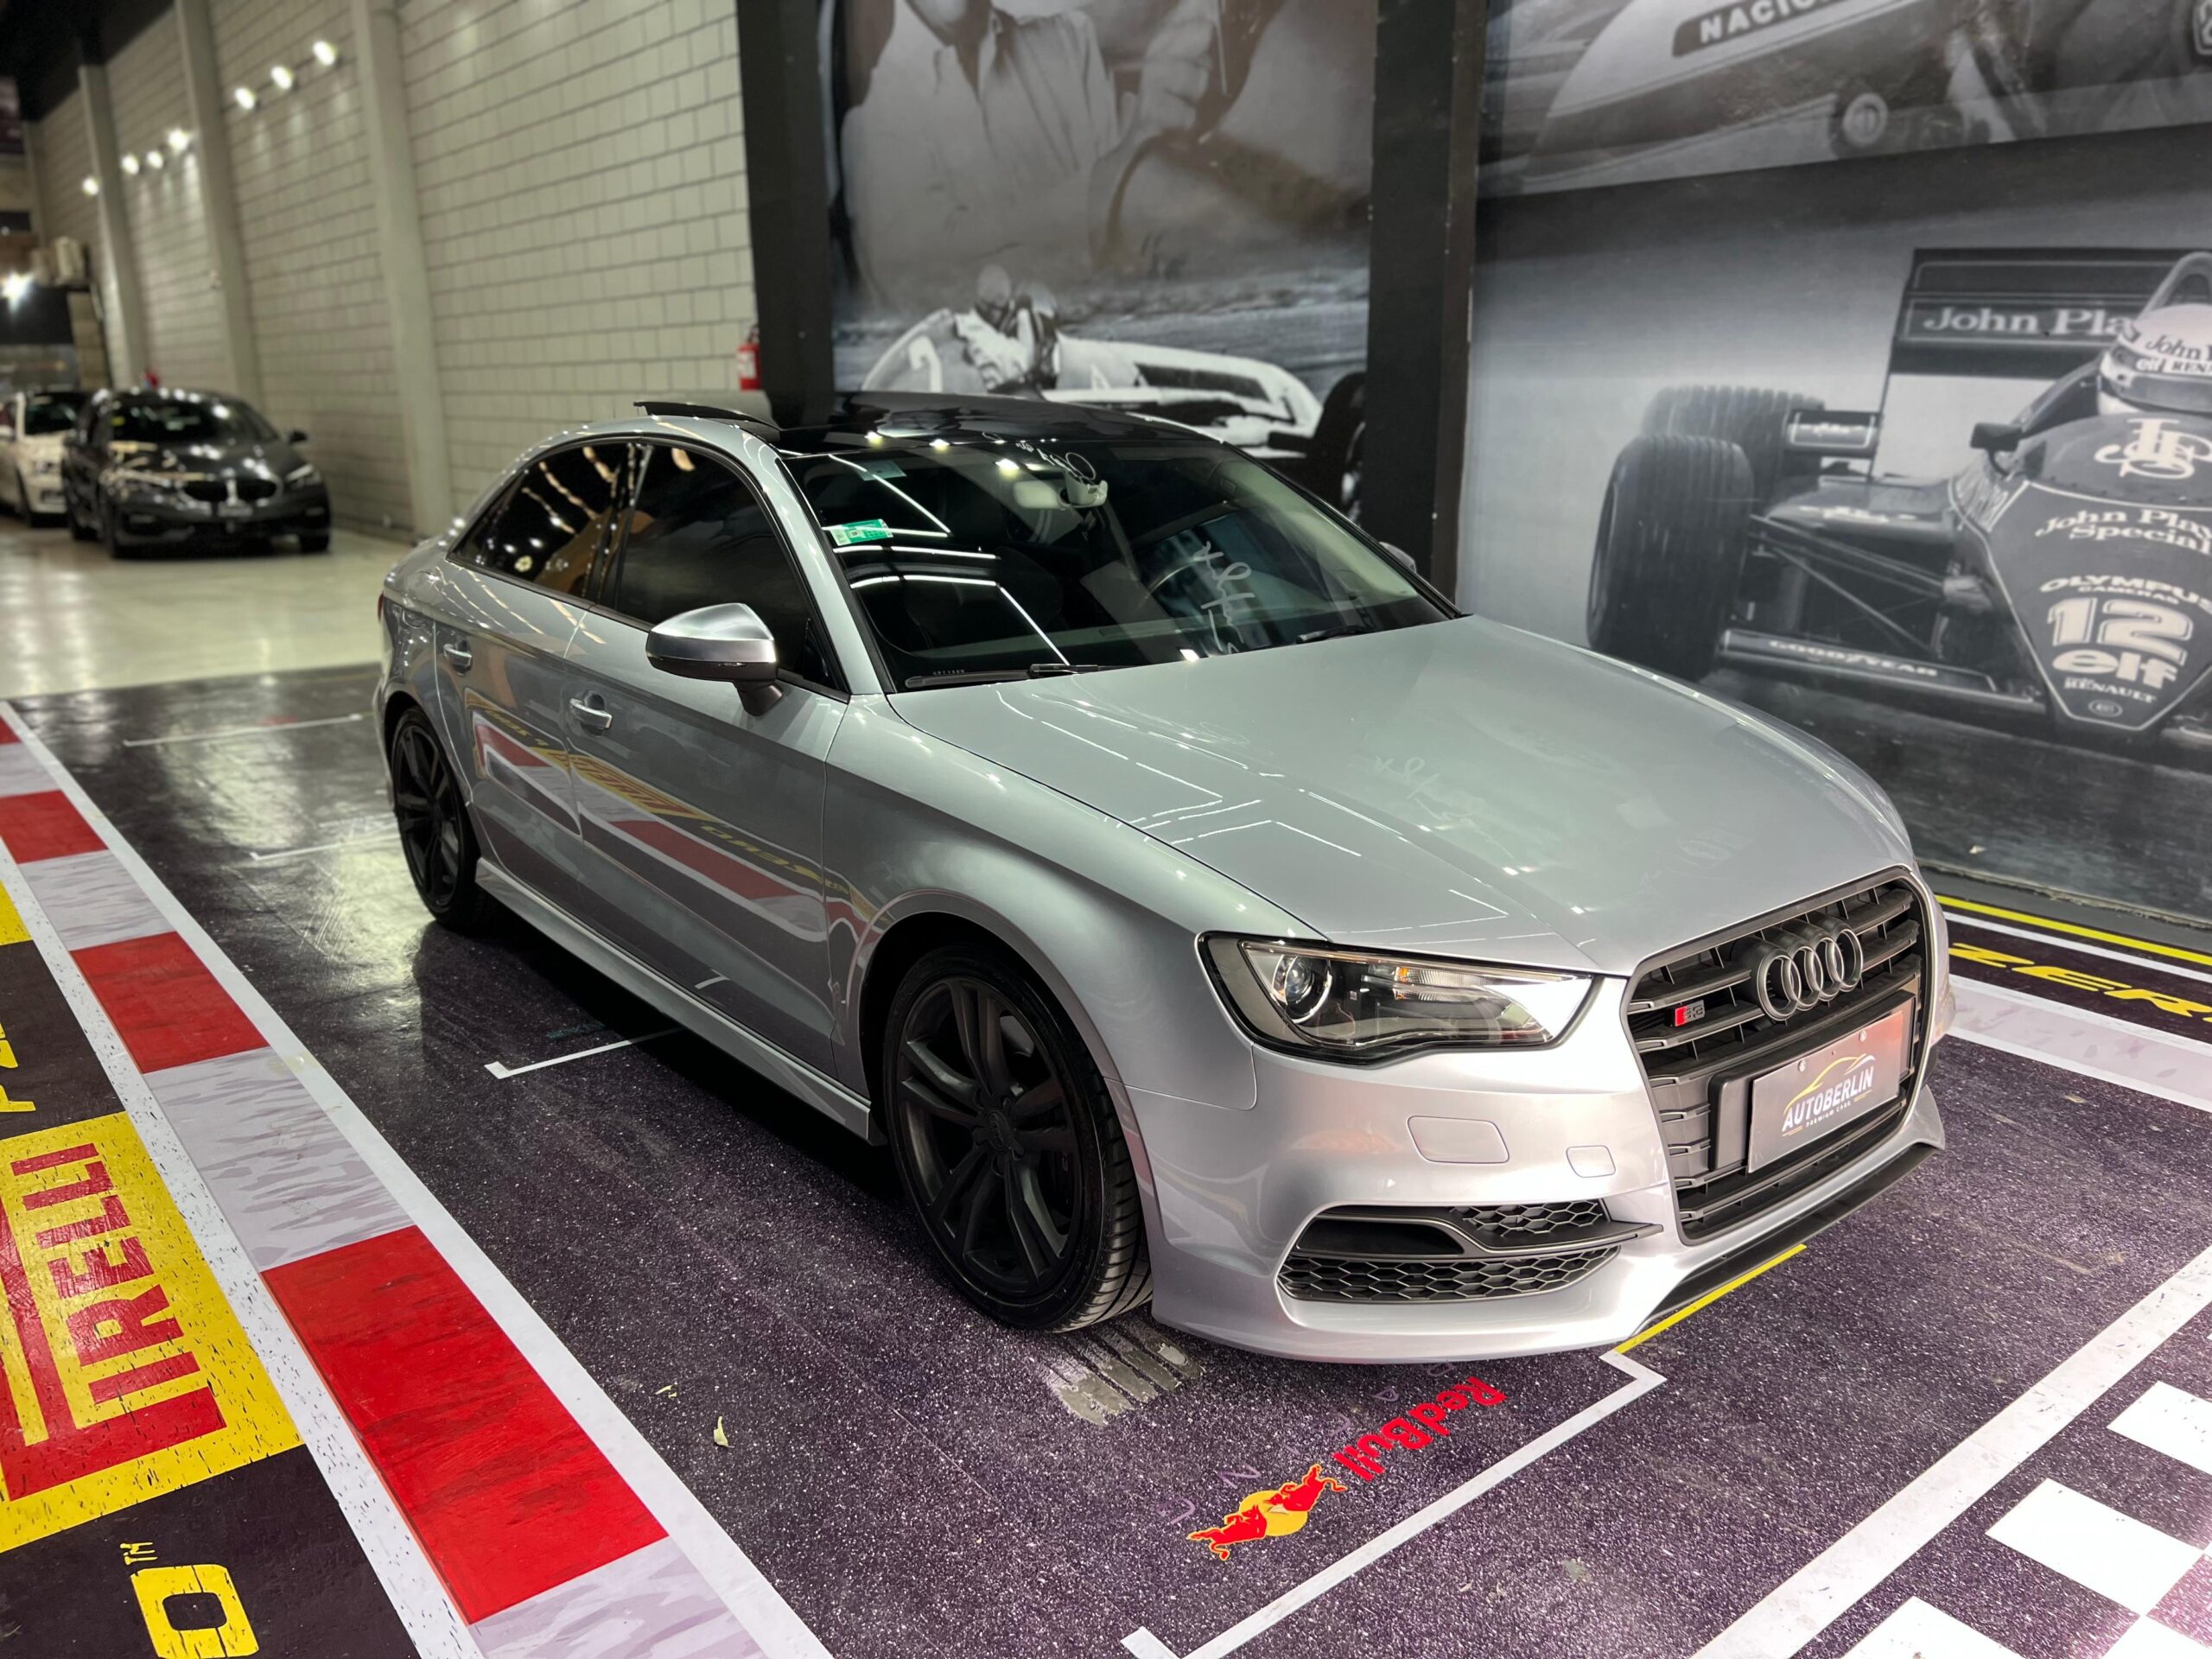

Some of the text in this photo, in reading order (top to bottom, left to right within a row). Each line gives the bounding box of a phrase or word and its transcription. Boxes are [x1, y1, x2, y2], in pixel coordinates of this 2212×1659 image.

[1923, 308, 2040, 332] John
[2145, 334, 2201, 359] John
[2172, 360, 2212, 373] REN
[2035, 511, 2126, 537] John
[2069, 524, 2210, 555] Special
[2047, 597, 2193, 666] 12
[2052, 649, 2177, 689] elf
[2064, 678, 2157, 702] RENAULT
[1948, 943, 2212, 1023] ZER
[1782, 1065, 1874, 1133] AUTOBERLIN
[0, 1143, 227, 1502] PIRELLI
